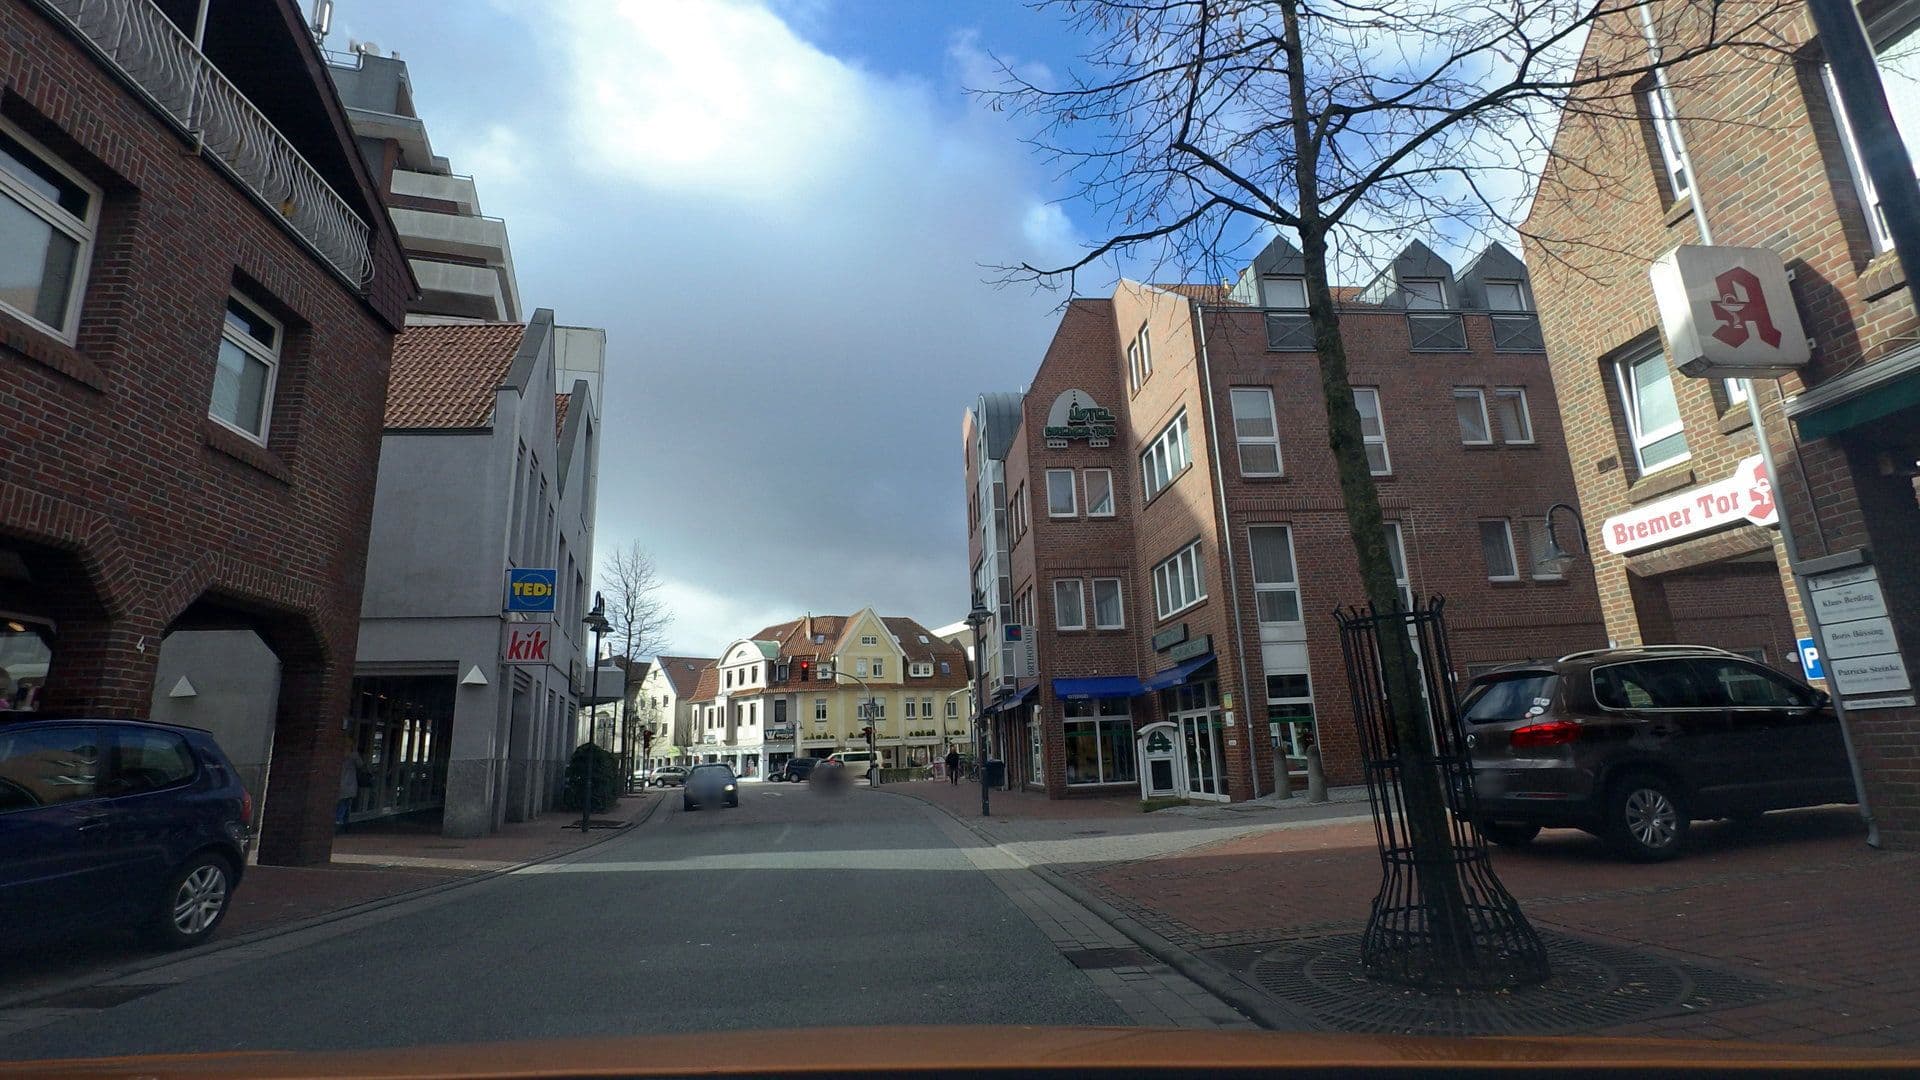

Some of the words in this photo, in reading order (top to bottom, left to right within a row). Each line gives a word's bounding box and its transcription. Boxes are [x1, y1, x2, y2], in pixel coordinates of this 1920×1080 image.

[1612, 507, 1691, 545] Bremer
[1696, 491, 1739, 519] Tor
[512, 582, 552, 596] TEDi
[136, 634, 145, 657] 4
[1803, 647, 1819, 669] P
